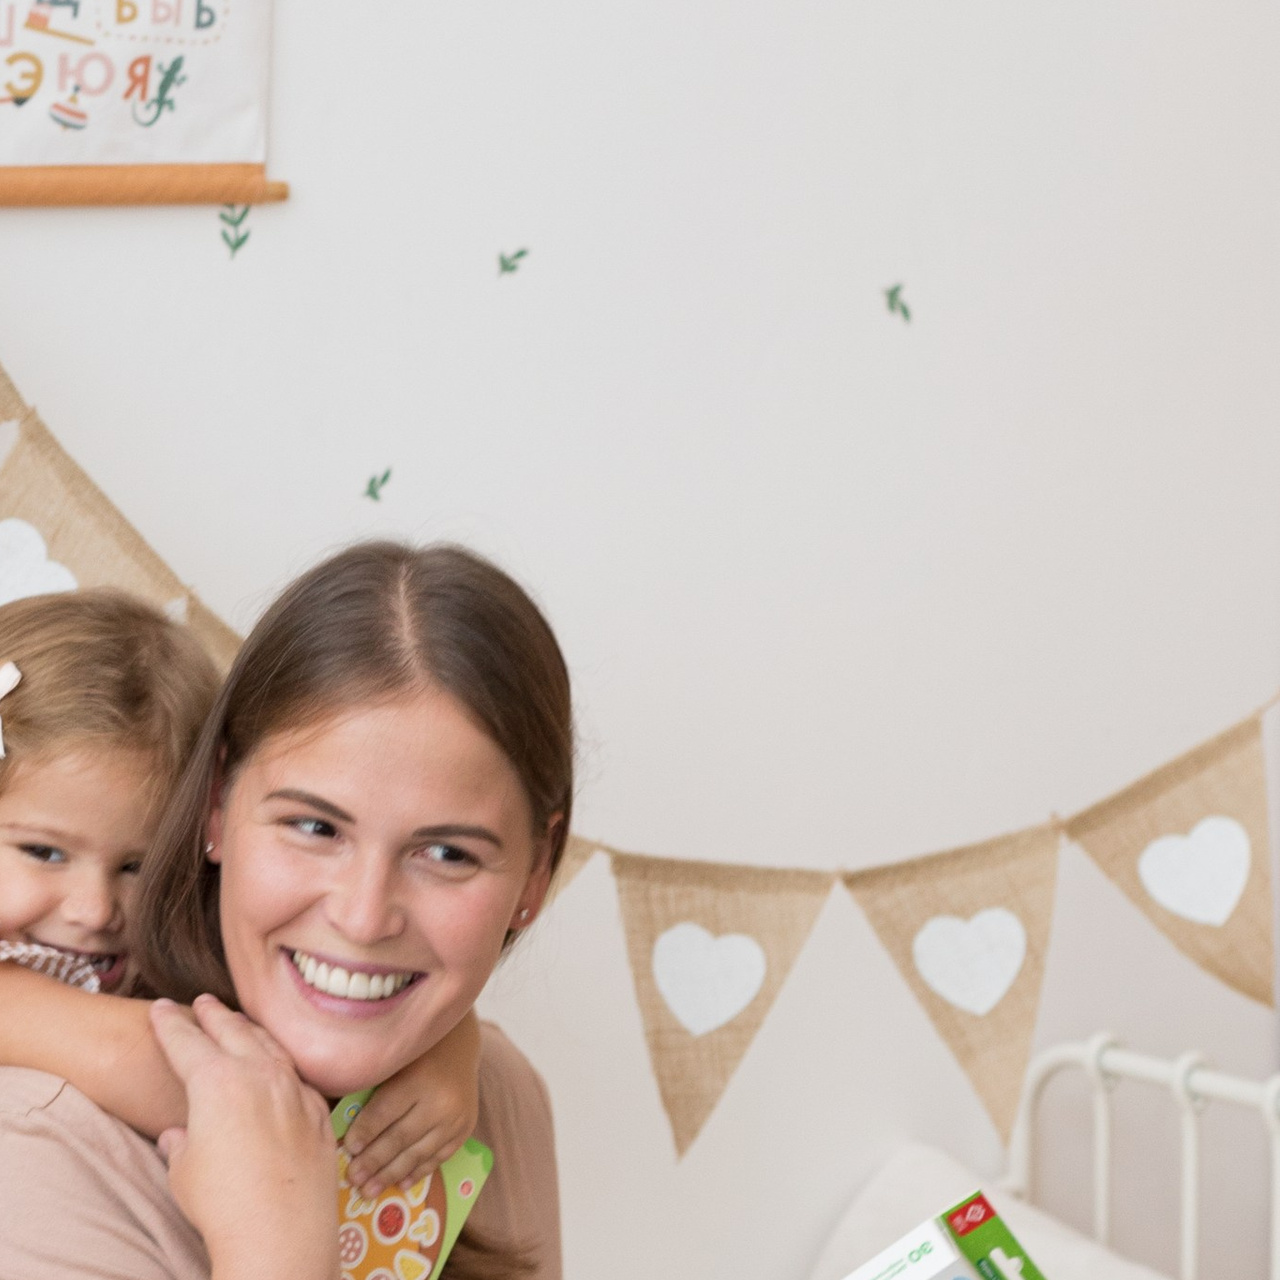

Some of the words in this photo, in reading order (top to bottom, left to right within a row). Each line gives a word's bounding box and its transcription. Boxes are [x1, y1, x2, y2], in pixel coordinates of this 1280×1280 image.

[5, 52, 43, 102] Э
[58, 51, 116, 97] Ю
[122, 54, 152, 102] Я
